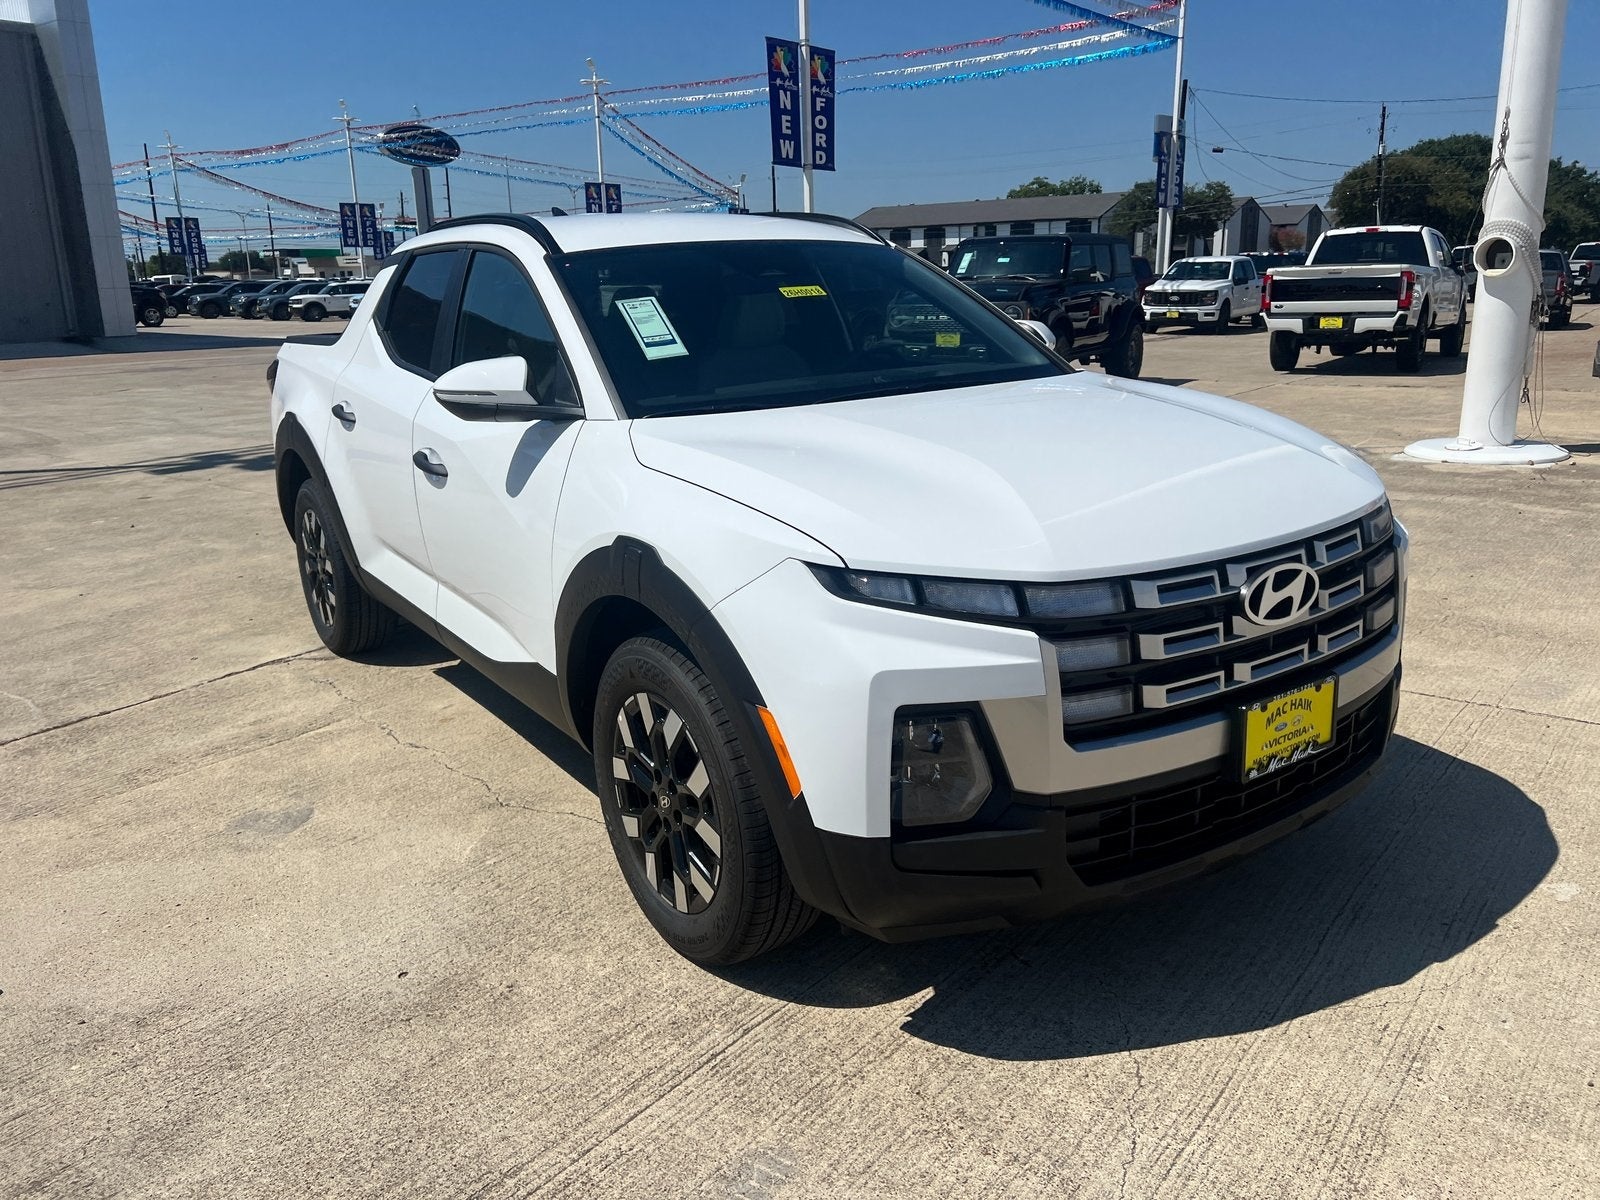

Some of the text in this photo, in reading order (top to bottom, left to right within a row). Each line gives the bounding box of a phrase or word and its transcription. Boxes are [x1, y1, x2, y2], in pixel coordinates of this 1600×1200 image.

[779, 89, 795, 160] NEW
[814, 97, 828, 165] FORD
[1158, 162, 1168, 204] NEW
[171, 231, 182, 253] NEW
[190, 232, 200, 254] FORD
[346, 220, 356, 246] NEW
[366, 221, 375, 246] FORD
[1265, 697, 1313, 730] MAC HAIK
[1268, 726, 1307, 749] VICTORIA
